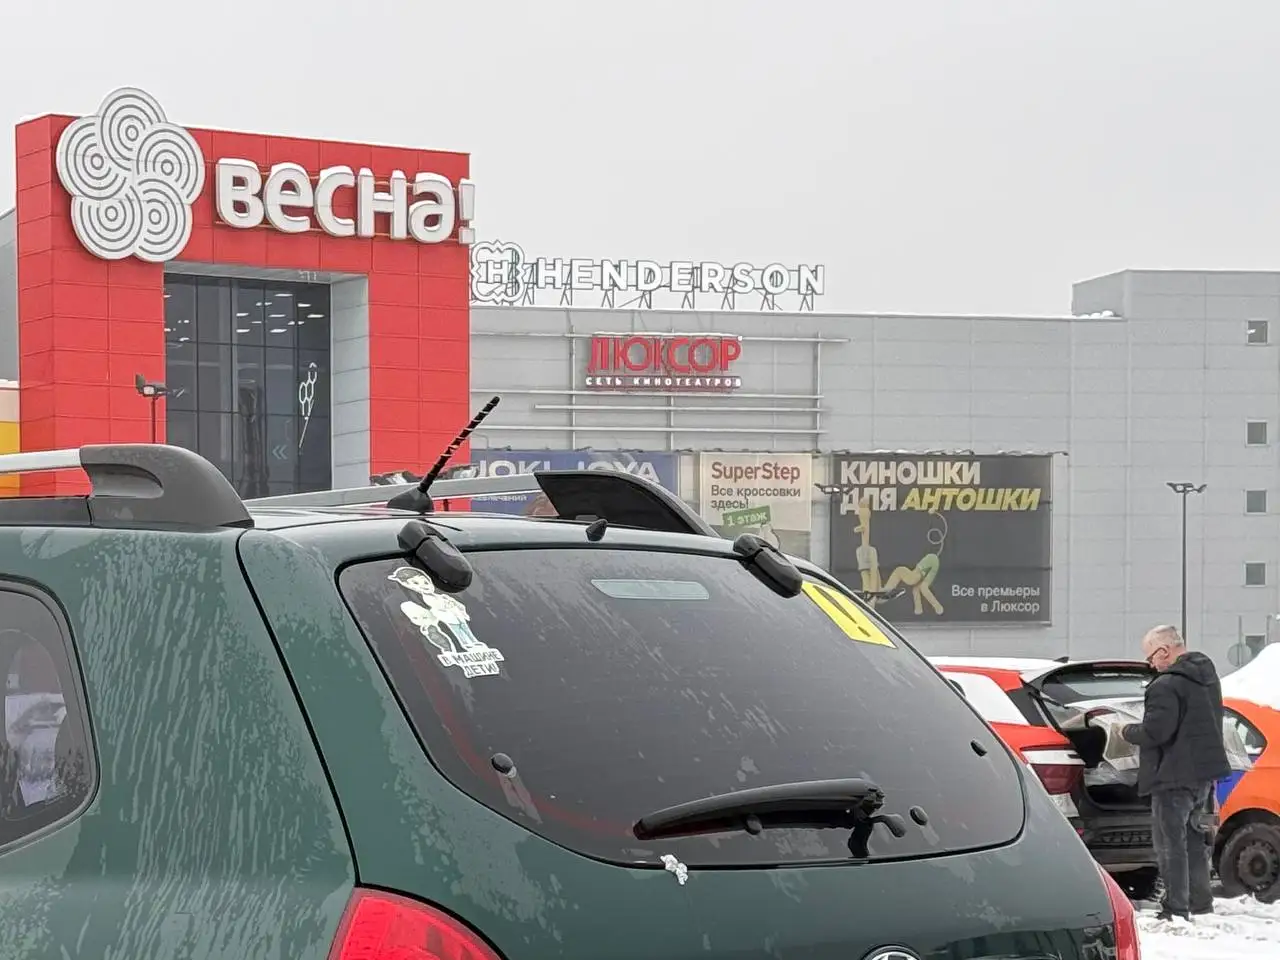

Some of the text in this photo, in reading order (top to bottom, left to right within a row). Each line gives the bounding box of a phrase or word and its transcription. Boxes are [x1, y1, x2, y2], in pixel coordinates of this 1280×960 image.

[537, 258, 825, 295] HENDERSON
[586, 336, 742, 373] ЛЮКСОР
[585, 376, 742, 387] СЕТЬ КИНОТЕАТРОВ
[711, 461, 800, 484] SuperStep
[840, 460, 981, 485] КИНОШКИ
[711, 484, 801, 499] Все кроссовки
[839, 486, 1041, 515] ДЛЯ АНТОШКИ
[727, 515, 735, 527] 1
[951, 585, 1040, 598] Все премьеры
[980, 600, 1040, 613] в Люксор
